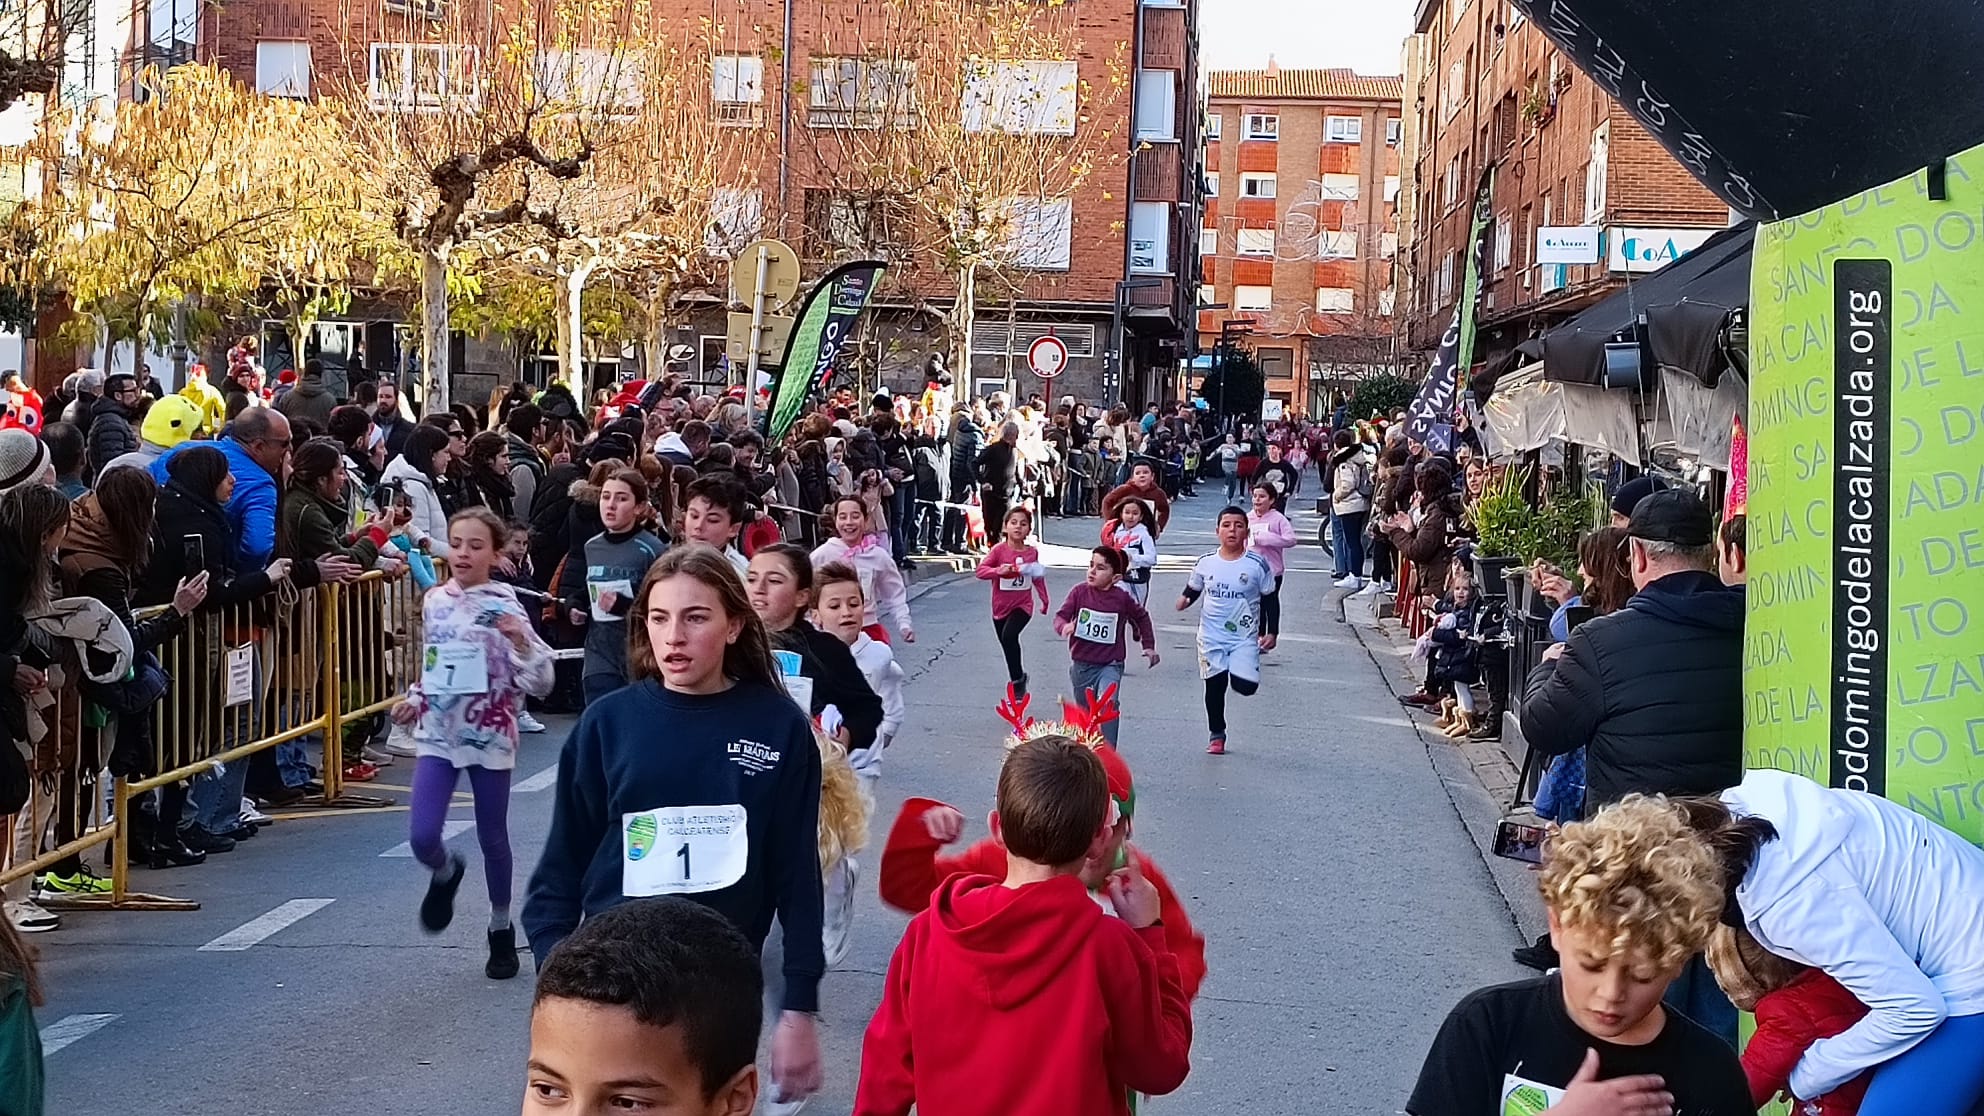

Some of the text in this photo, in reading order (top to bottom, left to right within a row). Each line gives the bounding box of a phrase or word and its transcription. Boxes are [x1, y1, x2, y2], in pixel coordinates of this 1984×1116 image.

[1621, 237, 1691, 263] CoA
[1895, 206, 1984, 264] DO
[1086, 622, 1109, 639] 196
[444, 664, 456, 687] 7
[1755, 687, 1782, 726] DE
[1788, 683, 1824, 722] LA
[676, 842, 691, 881] 1
